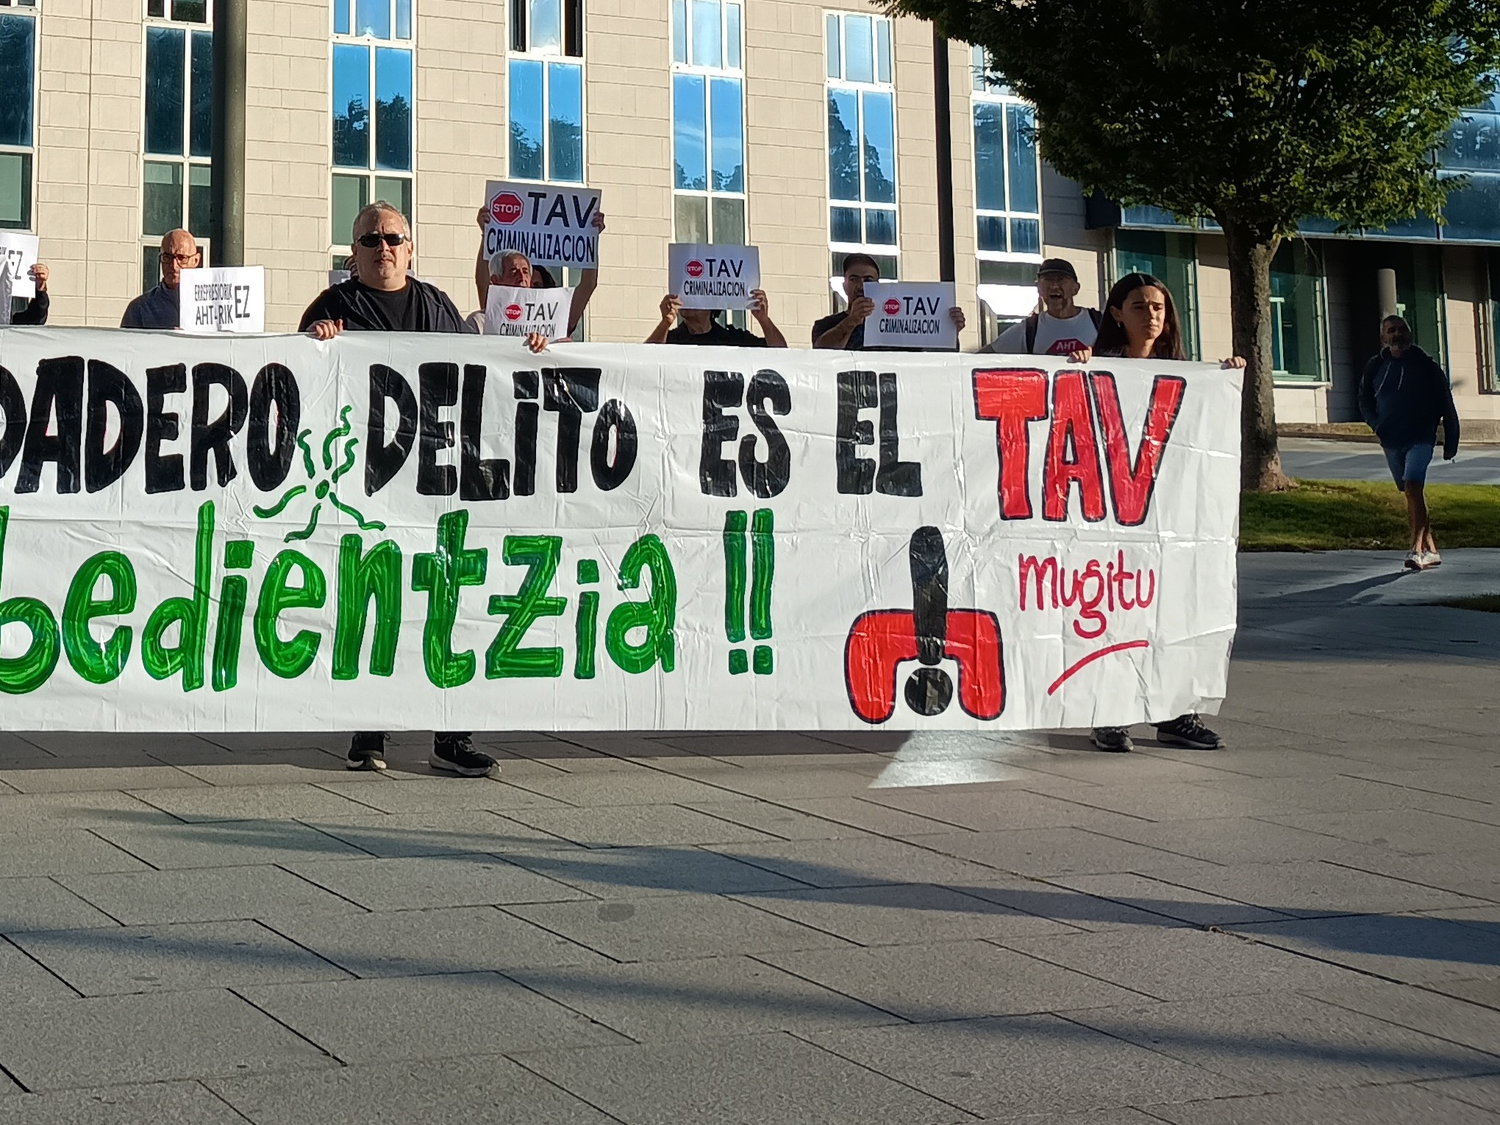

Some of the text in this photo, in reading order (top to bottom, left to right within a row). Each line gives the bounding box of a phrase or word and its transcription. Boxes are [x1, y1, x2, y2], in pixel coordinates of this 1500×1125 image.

[493, 192, 597, 228] STOP TAV
[486, 228, 595, 262] CRIMINALIZACION
[705, 259, 743, 277] TAV
[683, 280, 746, 297] CRIMINALIZACION
[234, 285, 251, 318] EZ
[525, 301, 559, 321] TAV
[902, 297, 940, 315] TAV
[195, 304, 234, 326] AHT-RIK
[879, 318, 940, 335] CRIMINALIZACION
[700, 368, 791, 498] ES
[836, 370, 922, 497] EL
[972, 368, 1187, 526] TAV
